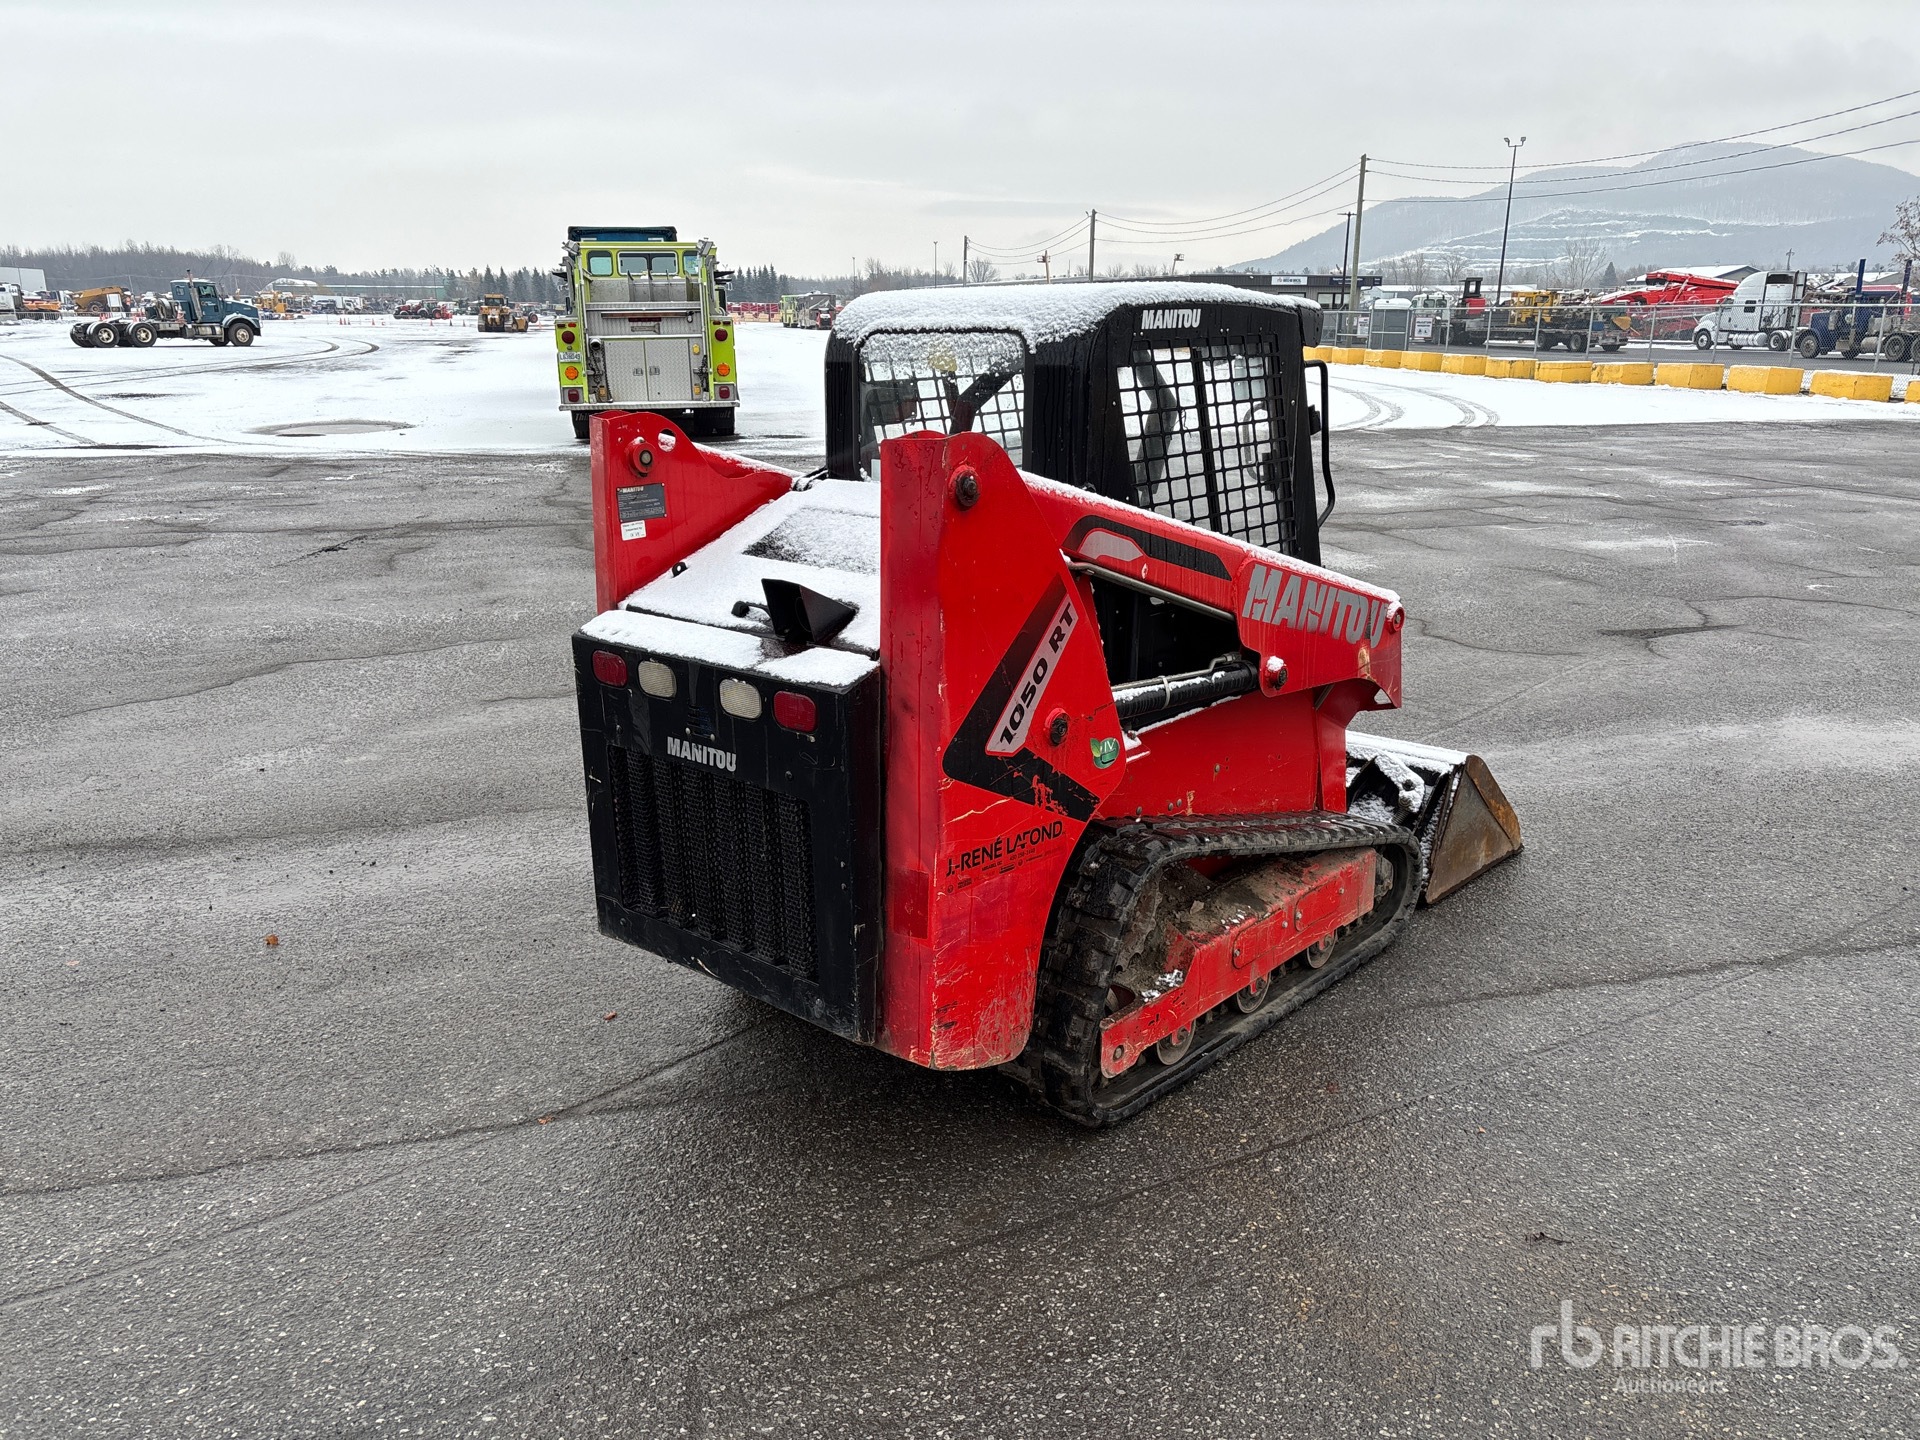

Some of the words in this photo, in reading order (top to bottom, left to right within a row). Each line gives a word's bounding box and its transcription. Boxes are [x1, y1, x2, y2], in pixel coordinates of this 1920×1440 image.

[1141, 308, 1201, 330] MANITOU
[1241, 563, 1388, 649] MANITOU
[1000, 657, 1048, 745] 1050
[1048, 602, 1074, 654] RT
[667, 736, 737, 772] MANITOU
[1006, 820, 1063, 855] LAFOND
